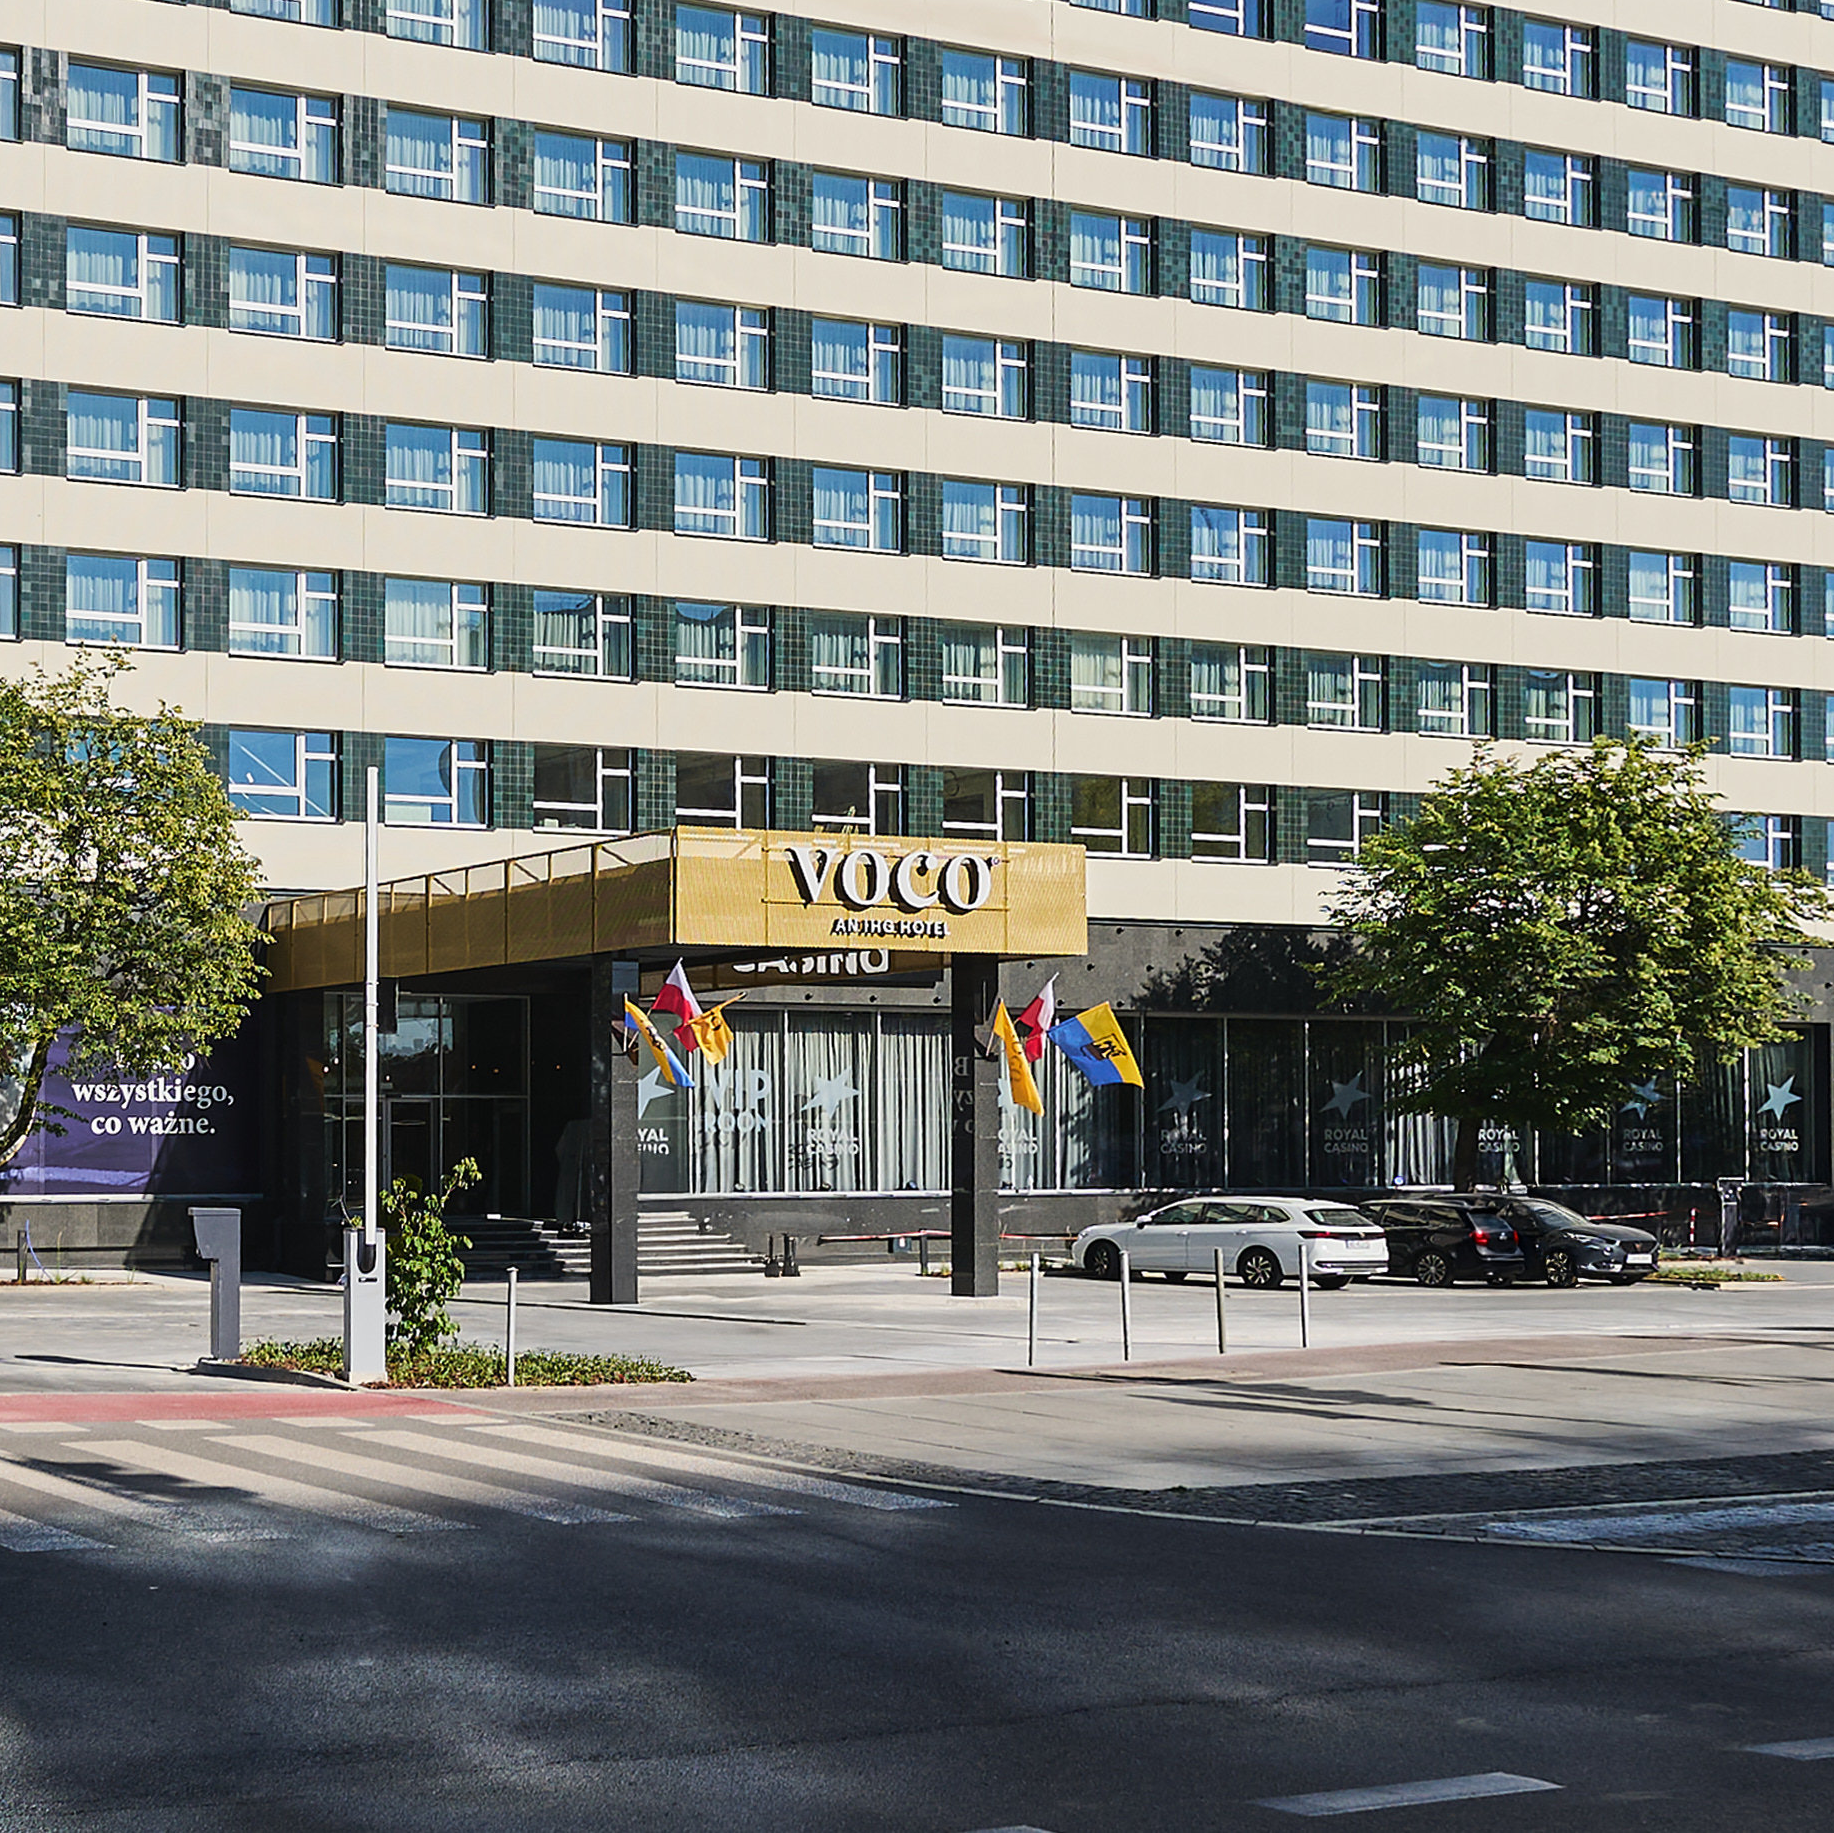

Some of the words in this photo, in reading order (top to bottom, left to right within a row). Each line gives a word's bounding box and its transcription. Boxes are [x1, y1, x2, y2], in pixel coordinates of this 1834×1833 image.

[835, 918, 858, 934] AN
[863, 920, 896, 935] IHG
[900, 921, 952, 936] HOTEL
[71, 1077, 234, 1109] wszystkiego,
[707, 1069, 772, 1109] VIP
[91, 1117, 122, 1134] co
[128, 1111, 216, 1135] ważne.
[998, 1128, 1038, 1142] OYAL
[1324, 1129, 1368, 1141] ROYAL
[1624, 1129, 1663, 1140] ROYAL
[1760, 1129, 1798, 1140] ROYAL
[1160, 1143, 1207, 1154] CASINO
[1324, 1142, 1368, 1154] CASINO
[1478, 1142, 1520, 1153] CASIO
[1623, 1142, 1663, 1152] CASINO
